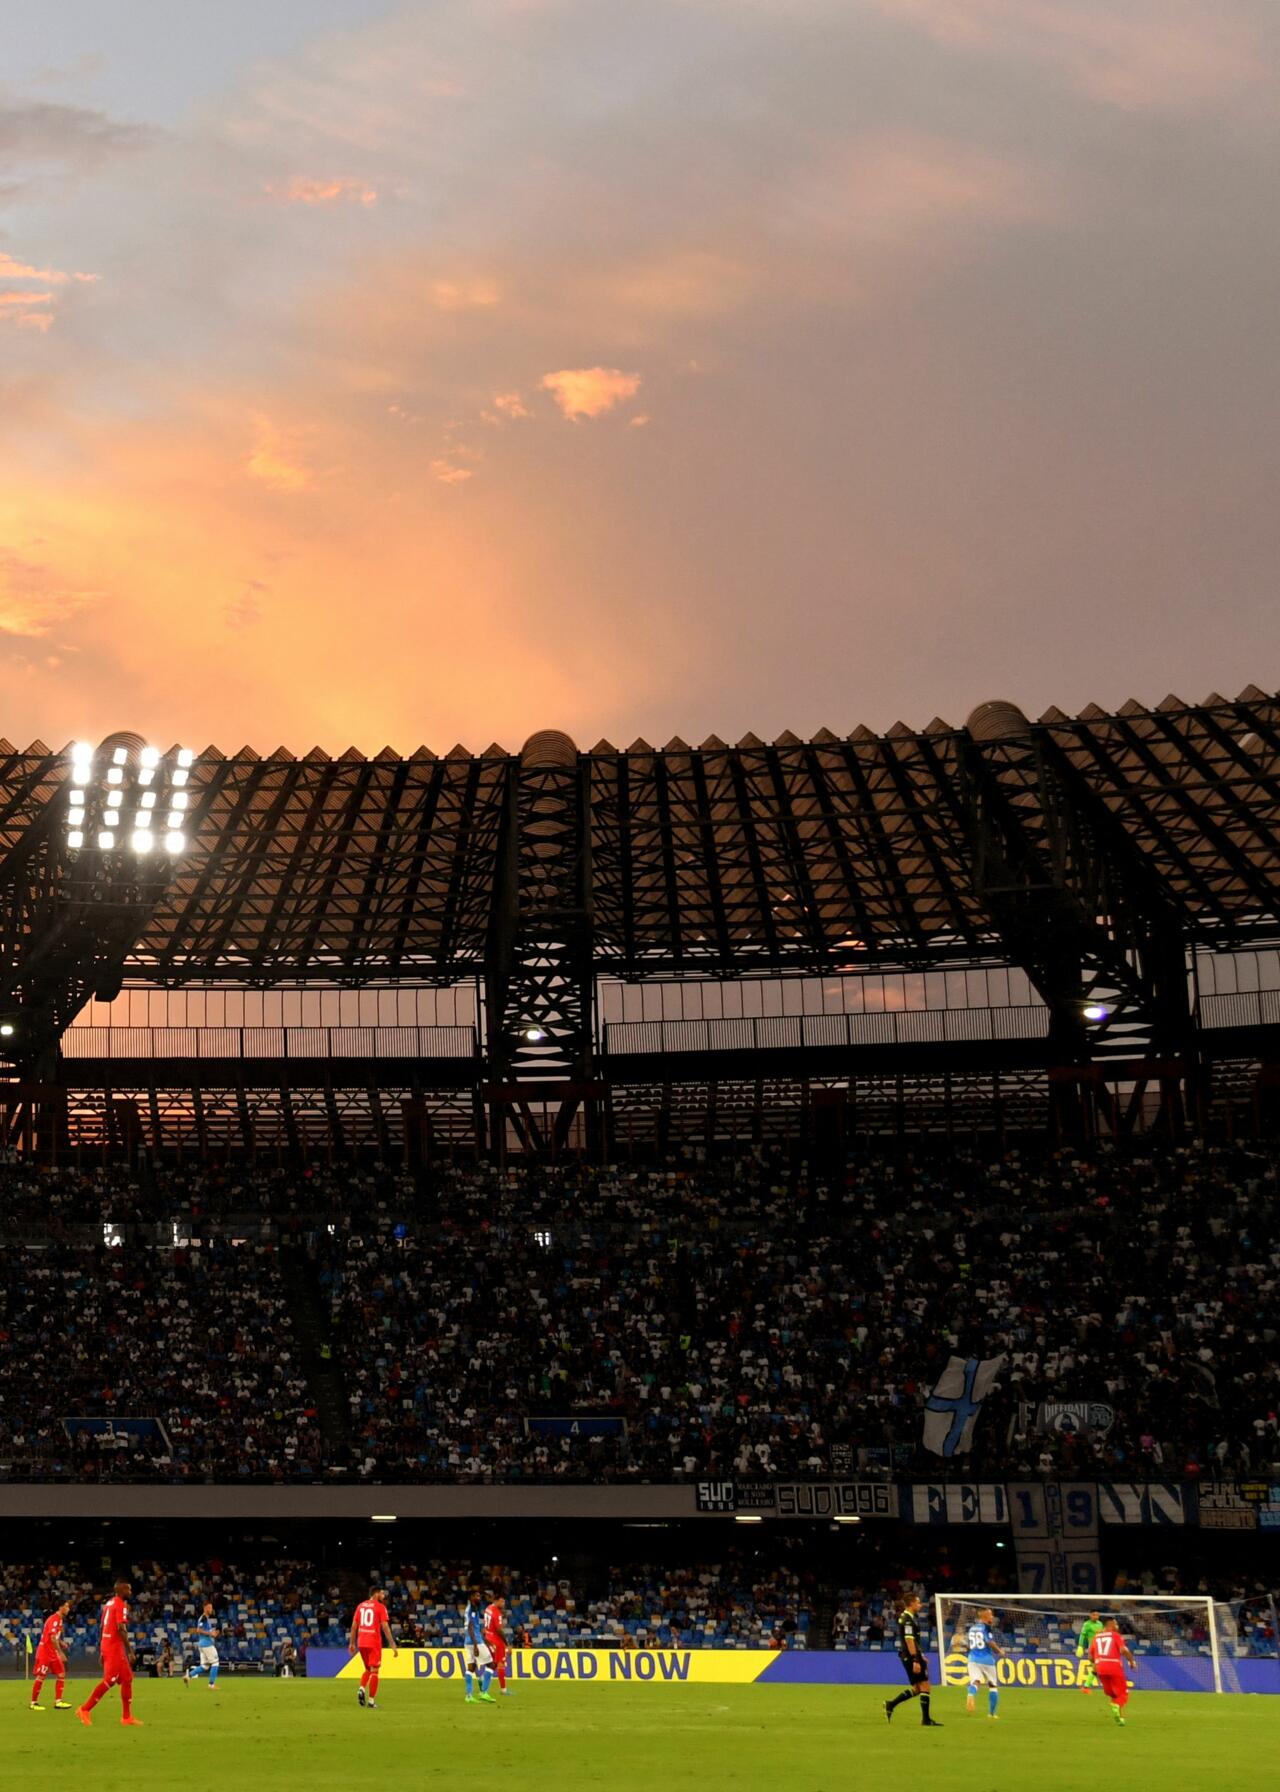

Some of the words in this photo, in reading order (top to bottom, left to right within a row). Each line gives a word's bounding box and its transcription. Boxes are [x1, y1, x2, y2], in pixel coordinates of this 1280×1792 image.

[570, 1420, 580, 1436] 4
[698, 1482, 734, 1501] SUD
[360, 1607, 374, 1627] 10
[1096, 1637, 1112, 1655] 17
[609, 1651, 691, 1680] NOW
